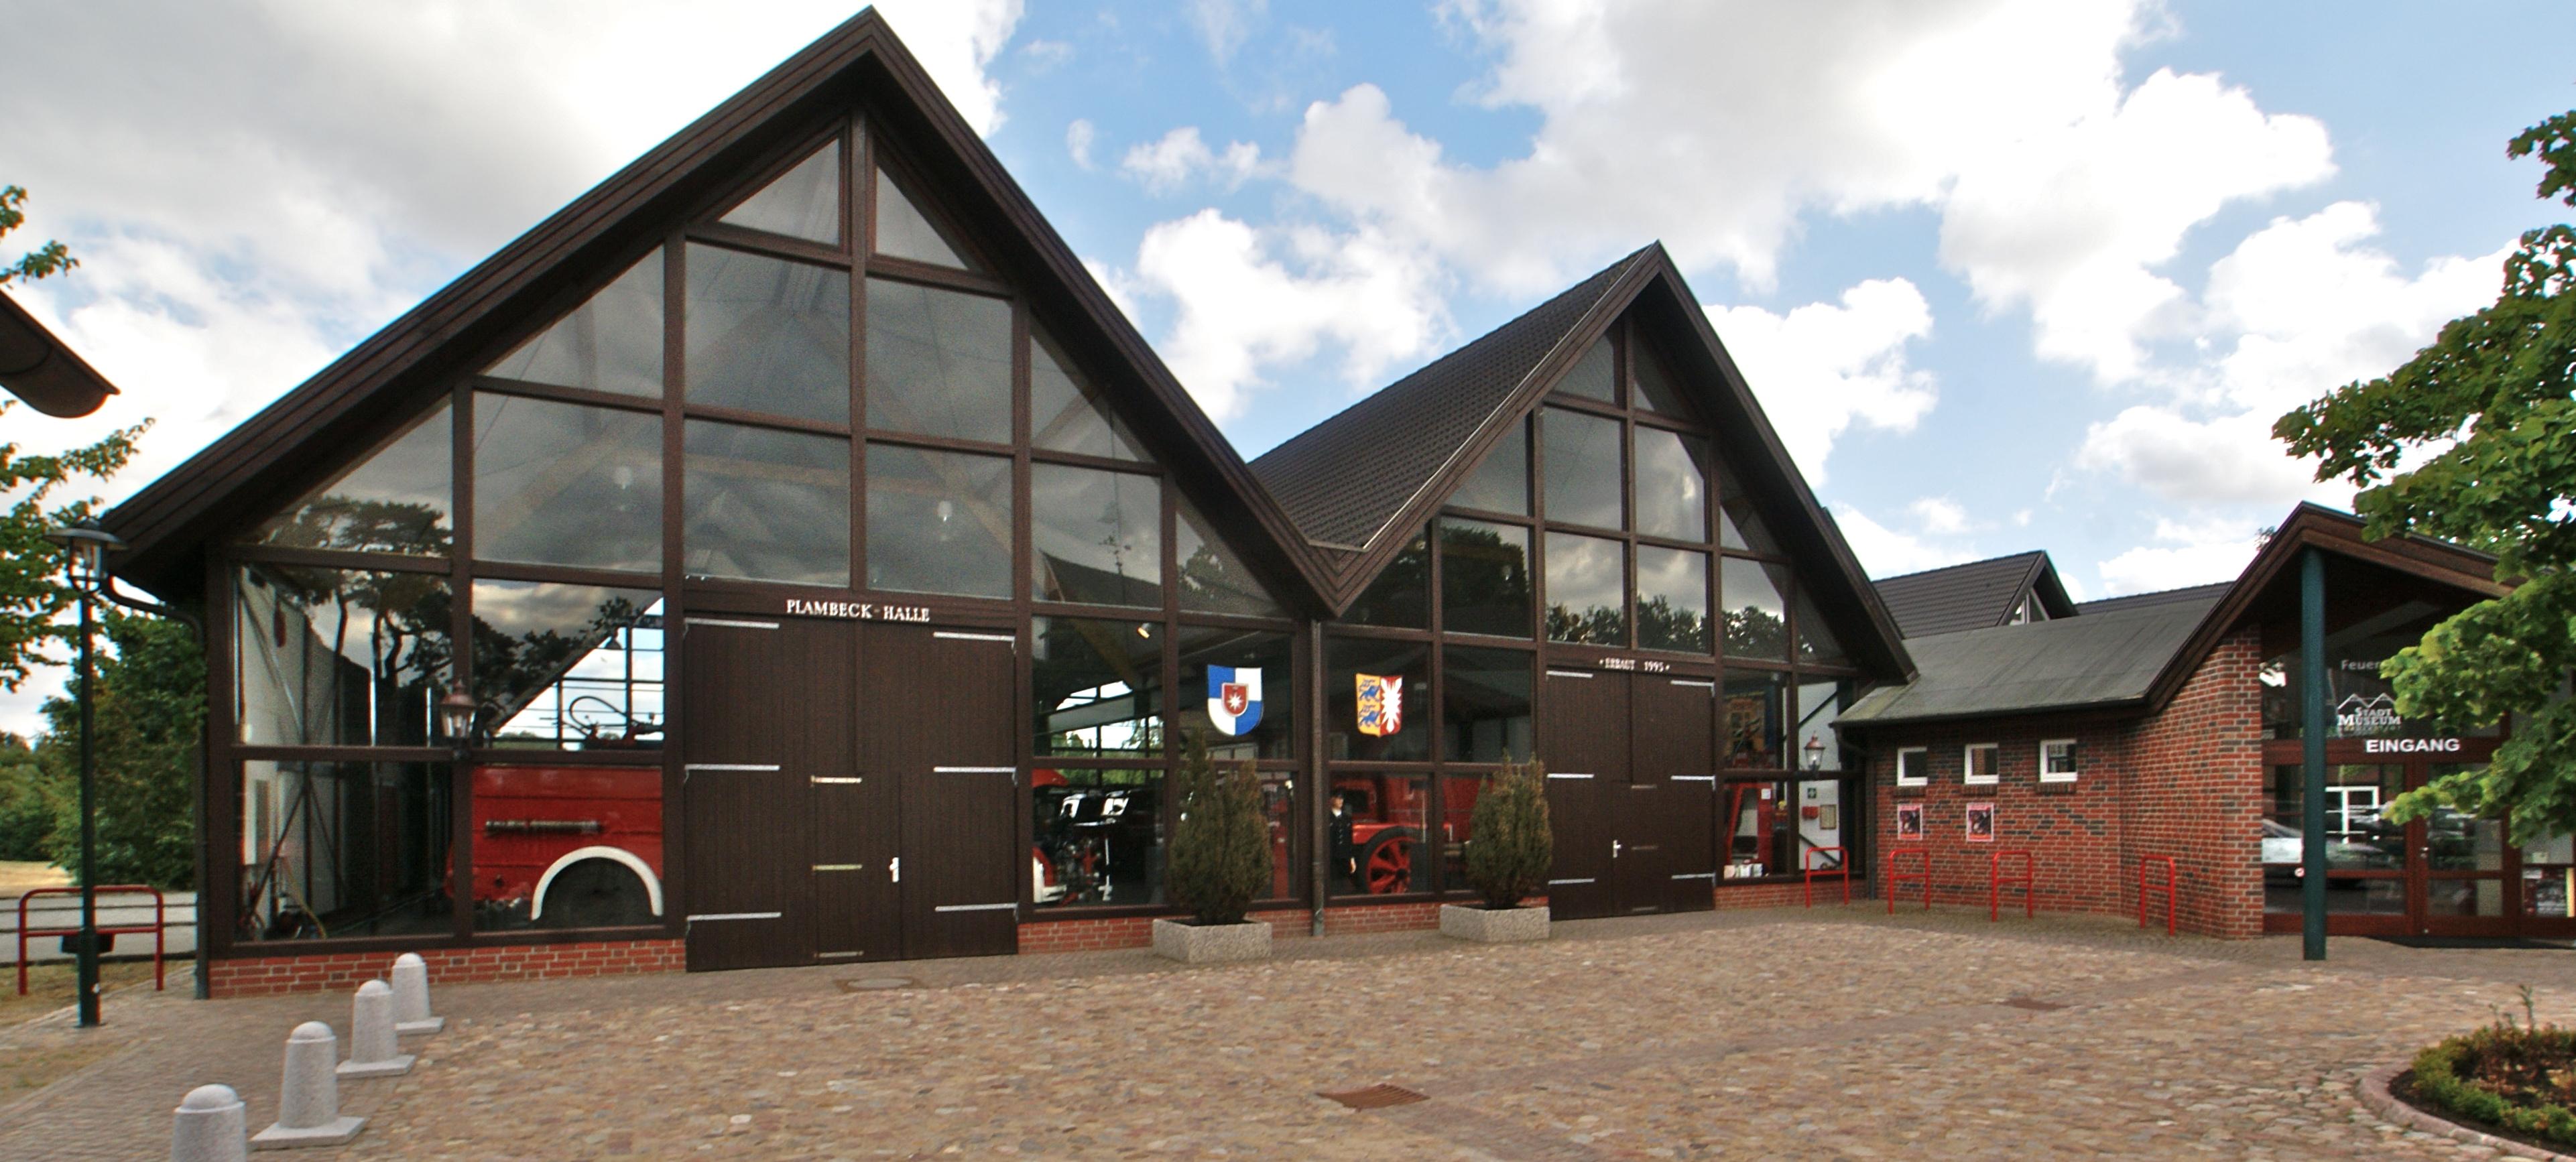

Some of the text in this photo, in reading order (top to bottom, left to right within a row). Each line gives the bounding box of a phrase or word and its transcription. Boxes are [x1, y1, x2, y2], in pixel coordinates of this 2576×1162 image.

[2341, 659, 2380, 670] Feuer
[2337, 714, 2401, 725] MUSEUM
[2366, 738, 2460, 753] EINGANG
